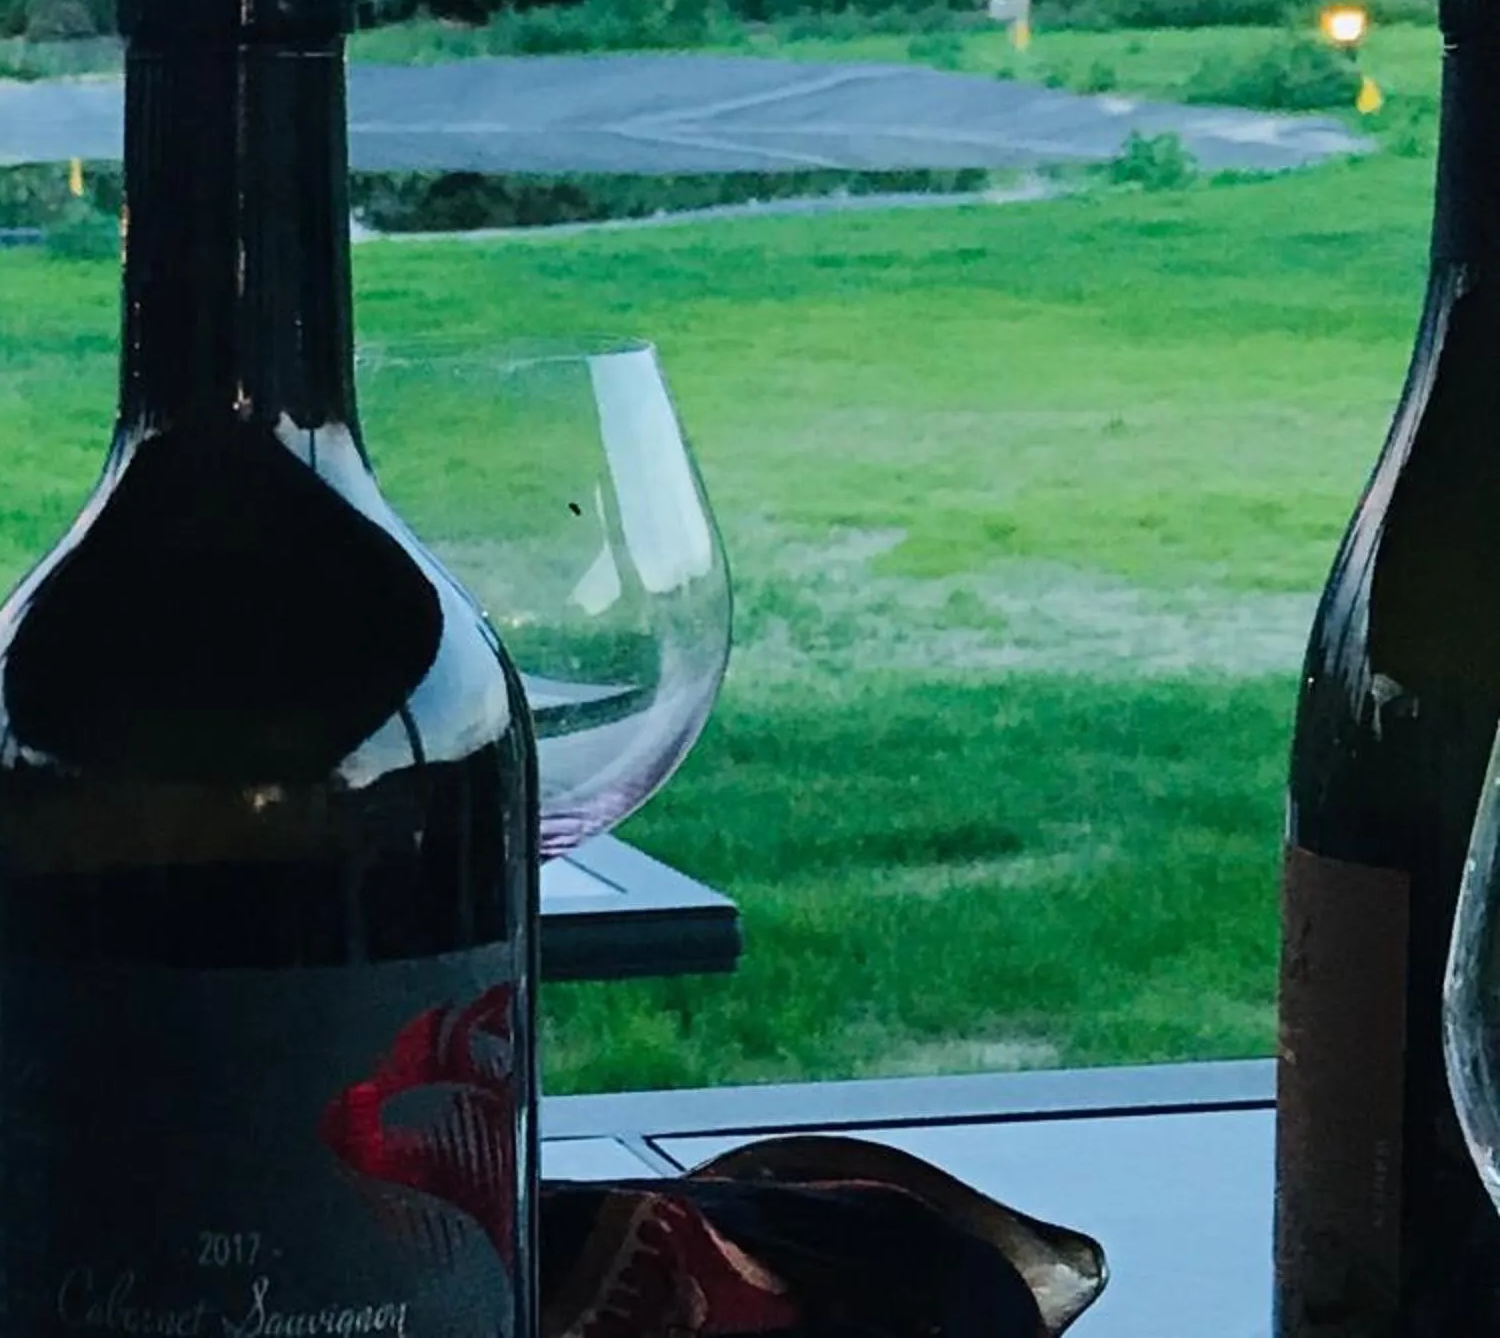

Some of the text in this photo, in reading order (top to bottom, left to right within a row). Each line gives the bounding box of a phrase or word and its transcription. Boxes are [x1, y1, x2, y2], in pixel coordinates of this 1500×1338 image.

[198, 1231, 261, 1266] 2017
[57, 1266, 408, 1338] Cabernet Sauvignon
